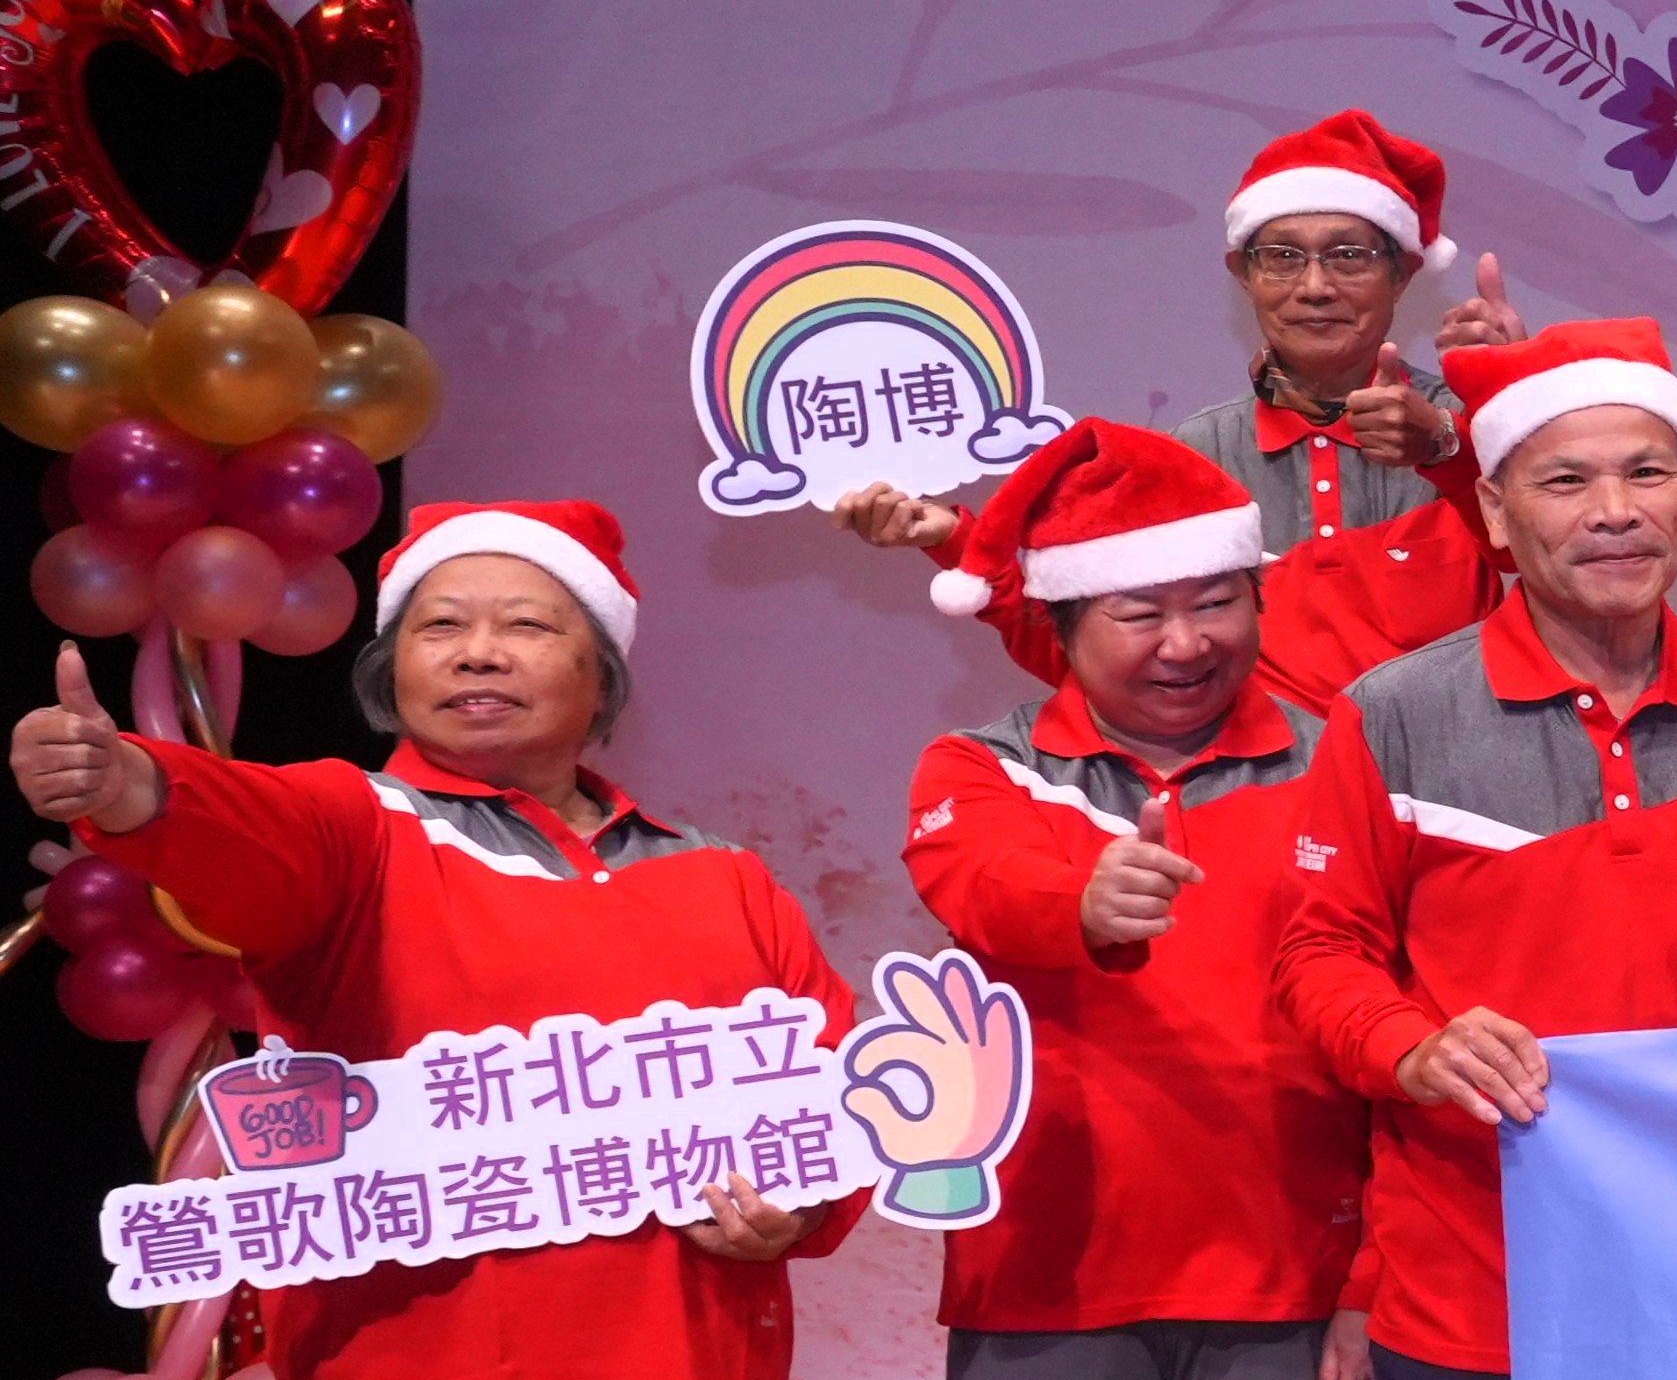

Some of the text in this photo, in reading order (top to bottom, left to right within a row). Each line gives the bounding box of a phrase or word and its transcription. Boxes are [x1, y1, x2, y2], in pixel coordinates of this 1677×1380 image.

[780, 361, 965, 455] 陶博
[240, 1095, 314, 1133] GOOD
[422, 1002, 823, 1132] 新北市立
[247, 1108, 326, 1159] JOB!
[118, 1107, 840, 1292] 鶯歌陶瓷博物館
